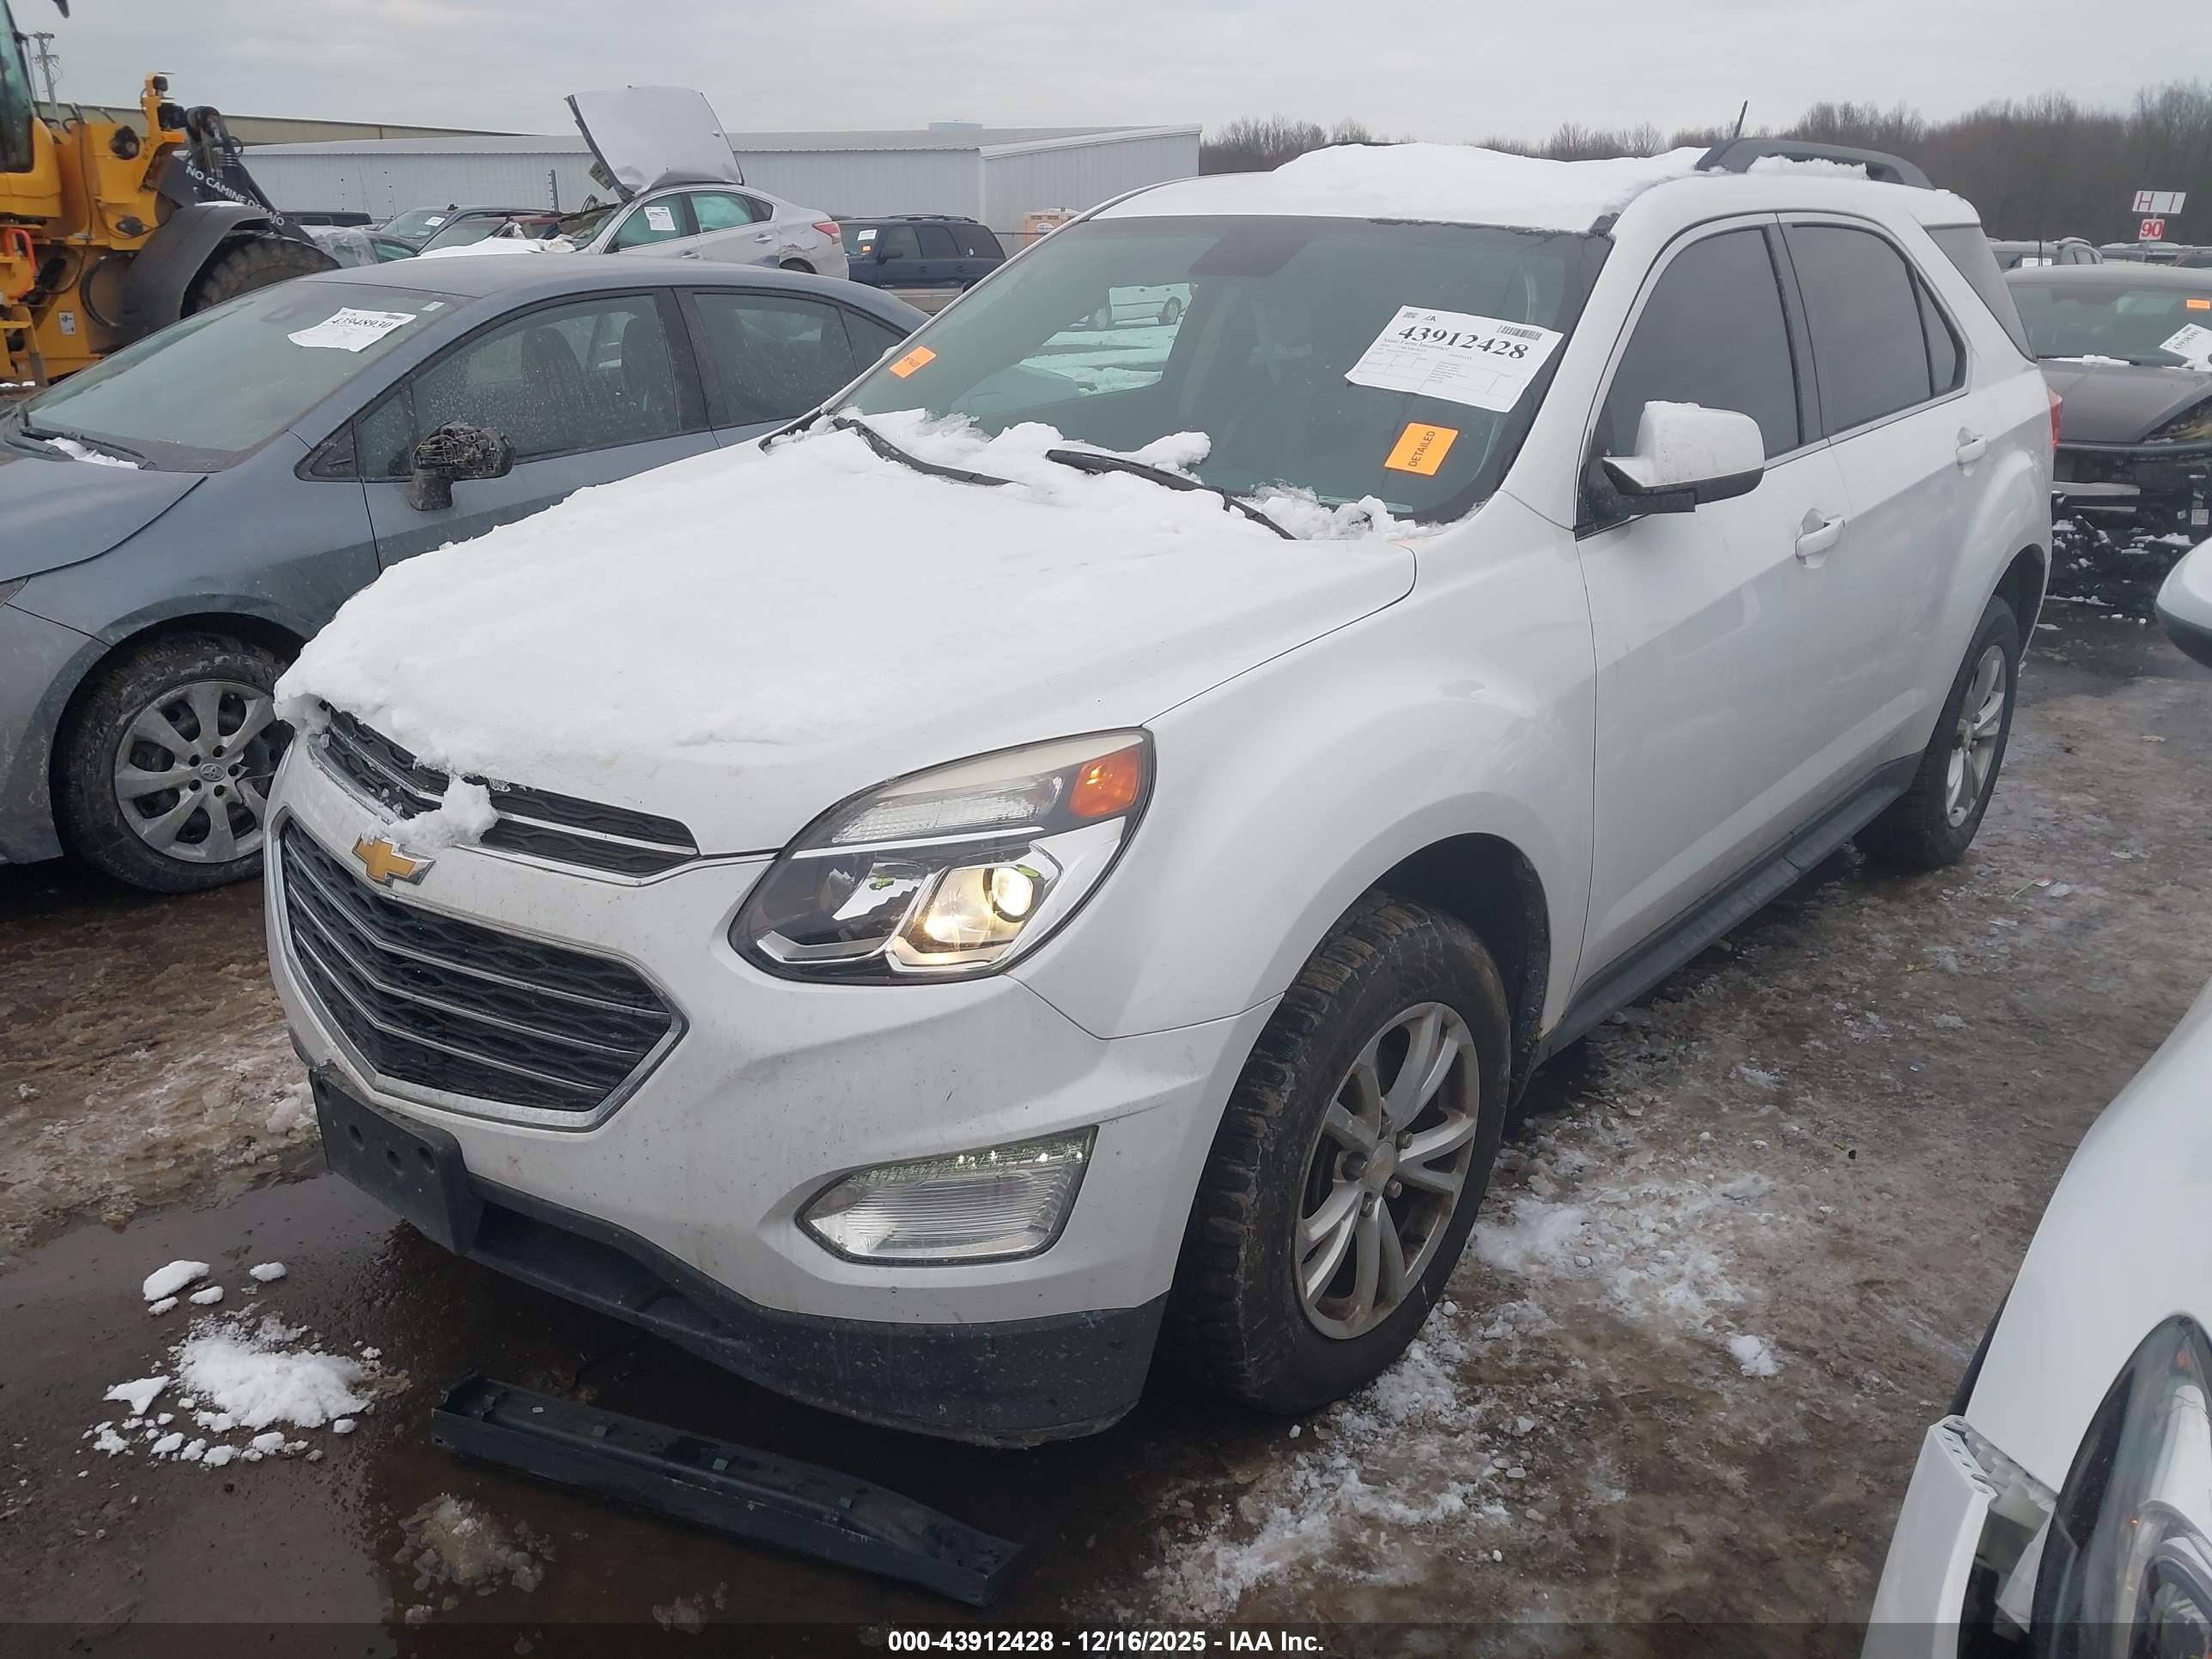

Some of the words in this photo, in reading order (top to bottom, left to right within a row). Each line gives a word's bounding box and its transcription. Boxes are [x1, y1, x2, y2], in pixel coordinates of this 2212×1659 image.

[185, 165, 205, 181] NO
[206, 177, 246, 205] CAMINE
[2136, 191, 2155, 211] H
[2141, 221, 2162, 237] 90
[1398, 325, 1529, 359] 43912428
[1408, 430, 1436, 467] DETAILED
